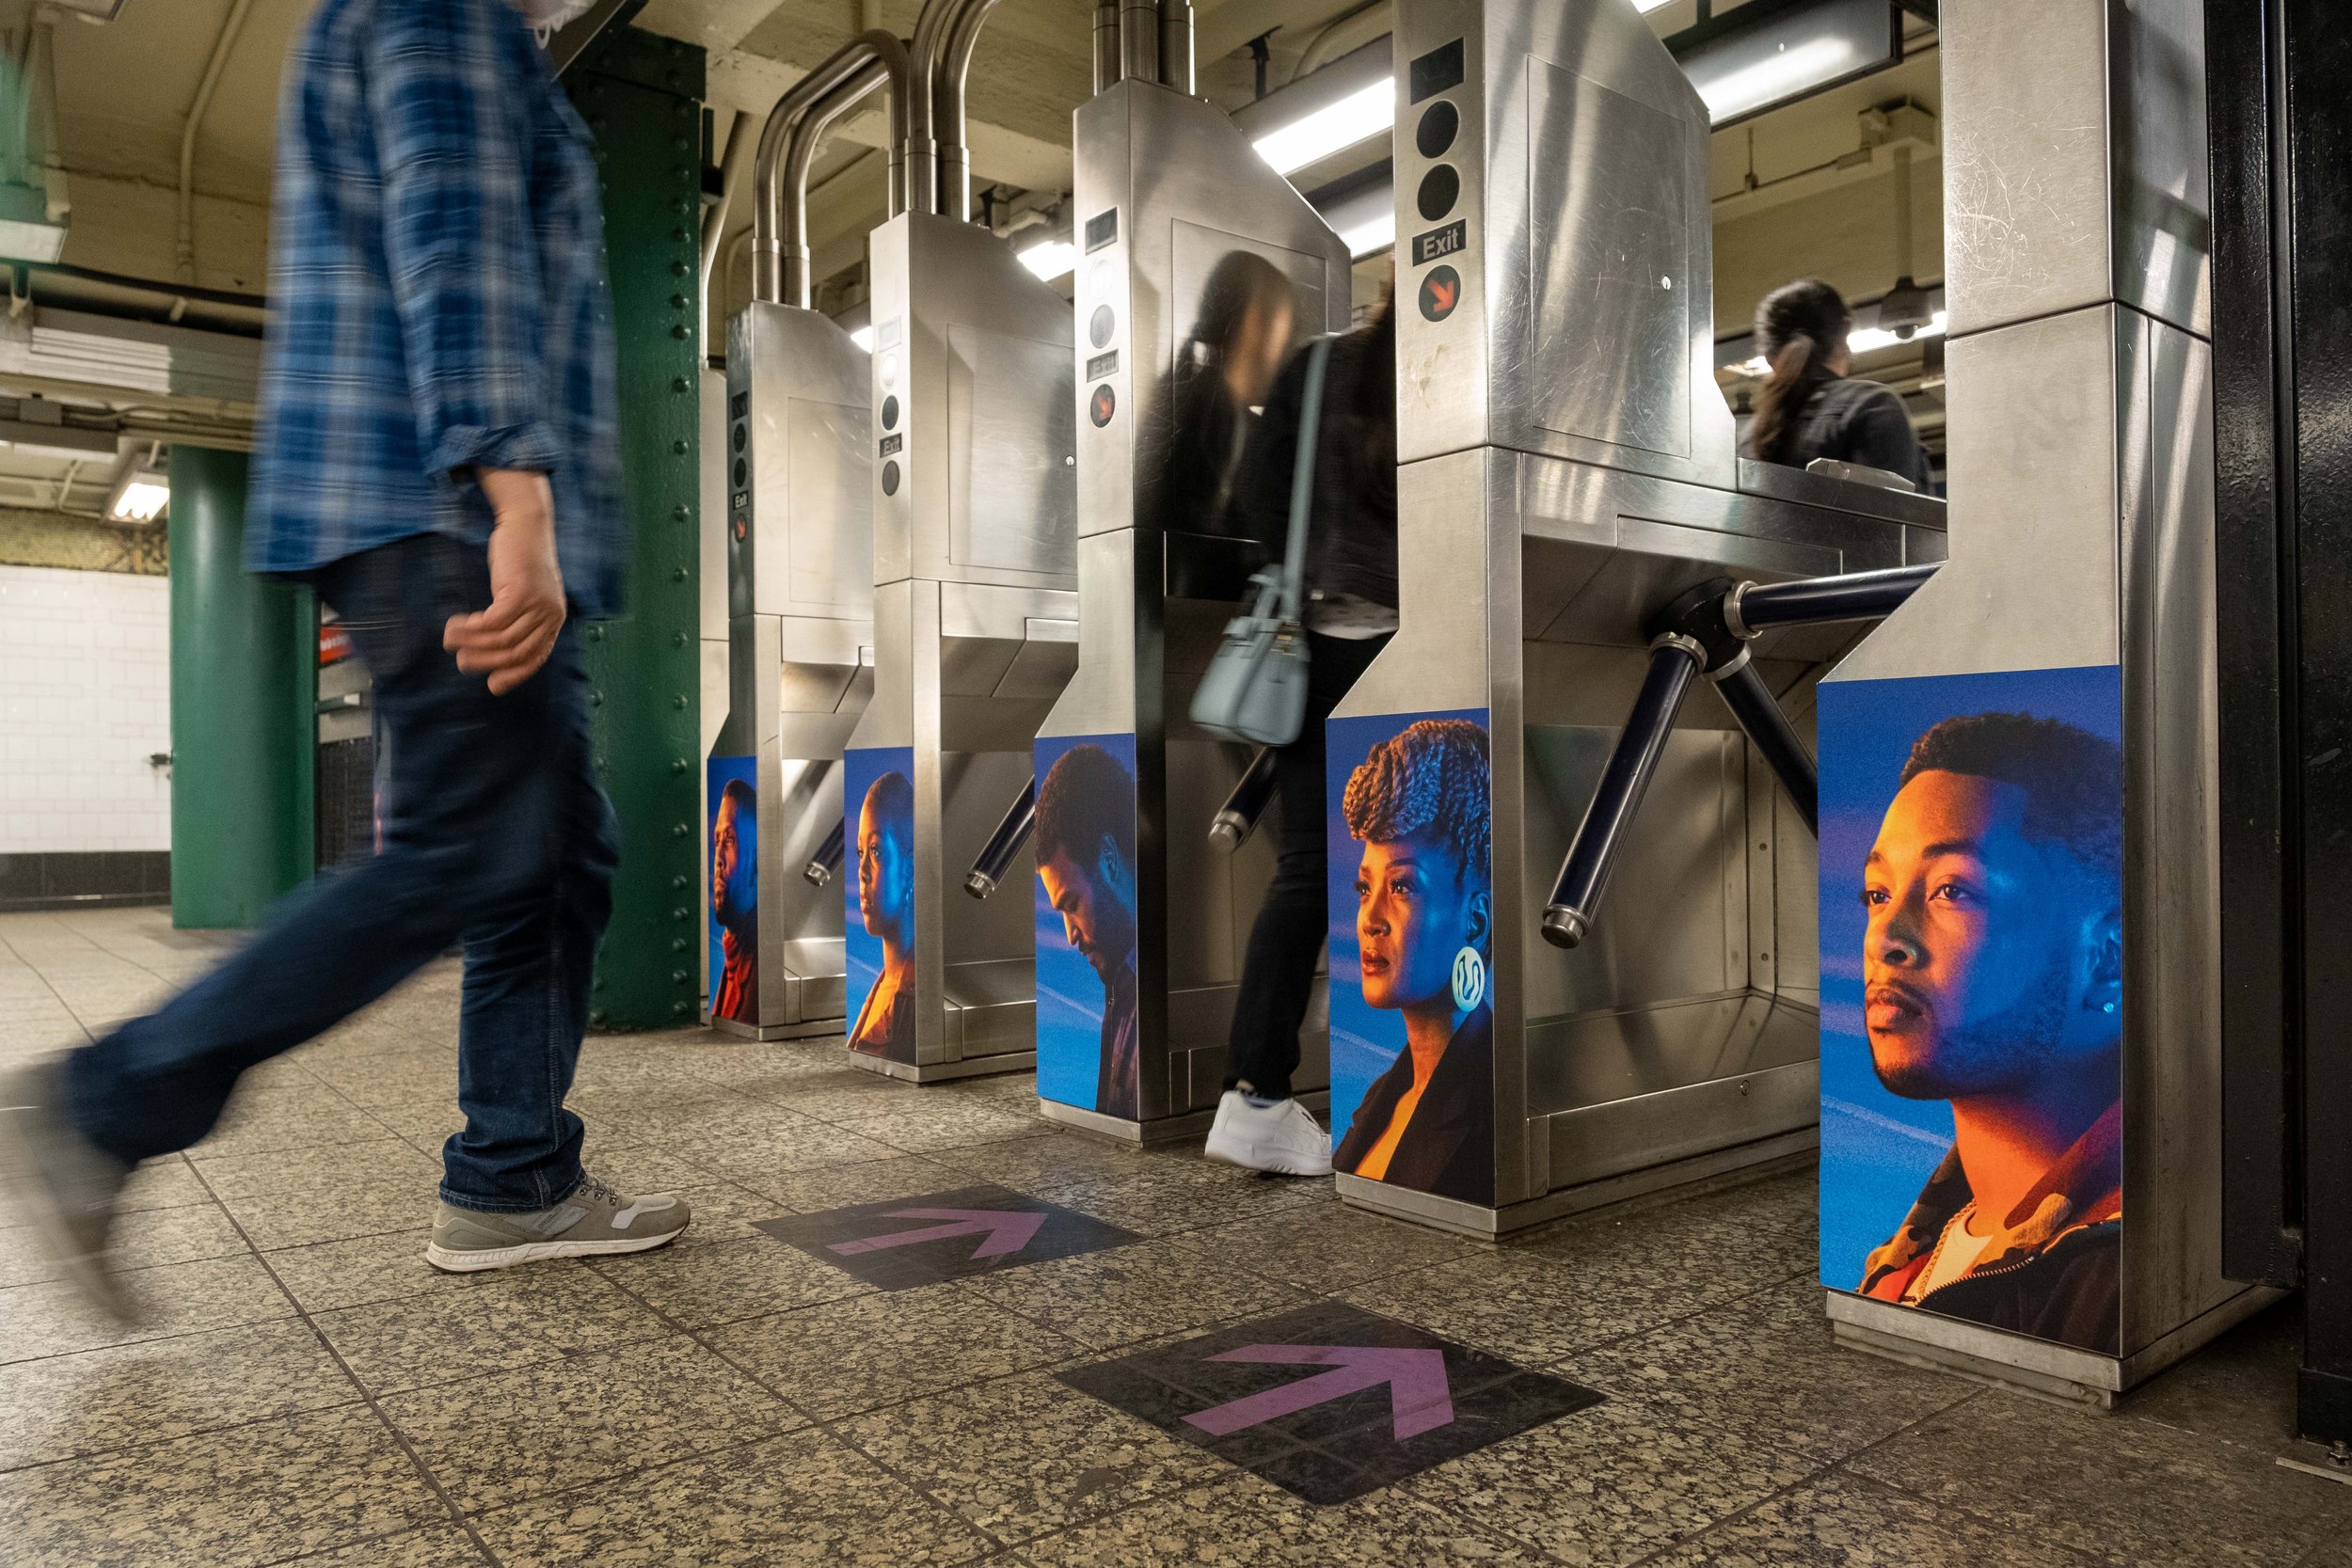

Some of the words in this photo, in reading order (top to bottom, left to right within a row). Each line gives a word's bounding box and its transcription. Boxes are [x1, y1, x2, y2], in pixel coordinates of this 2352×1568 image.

[1422, 229, 1458, 260] Exit
[1092, 355, 1116, 376] Exit
[883, 436, 900, 455] Exit
[735, 494, 747, 508] Exit
